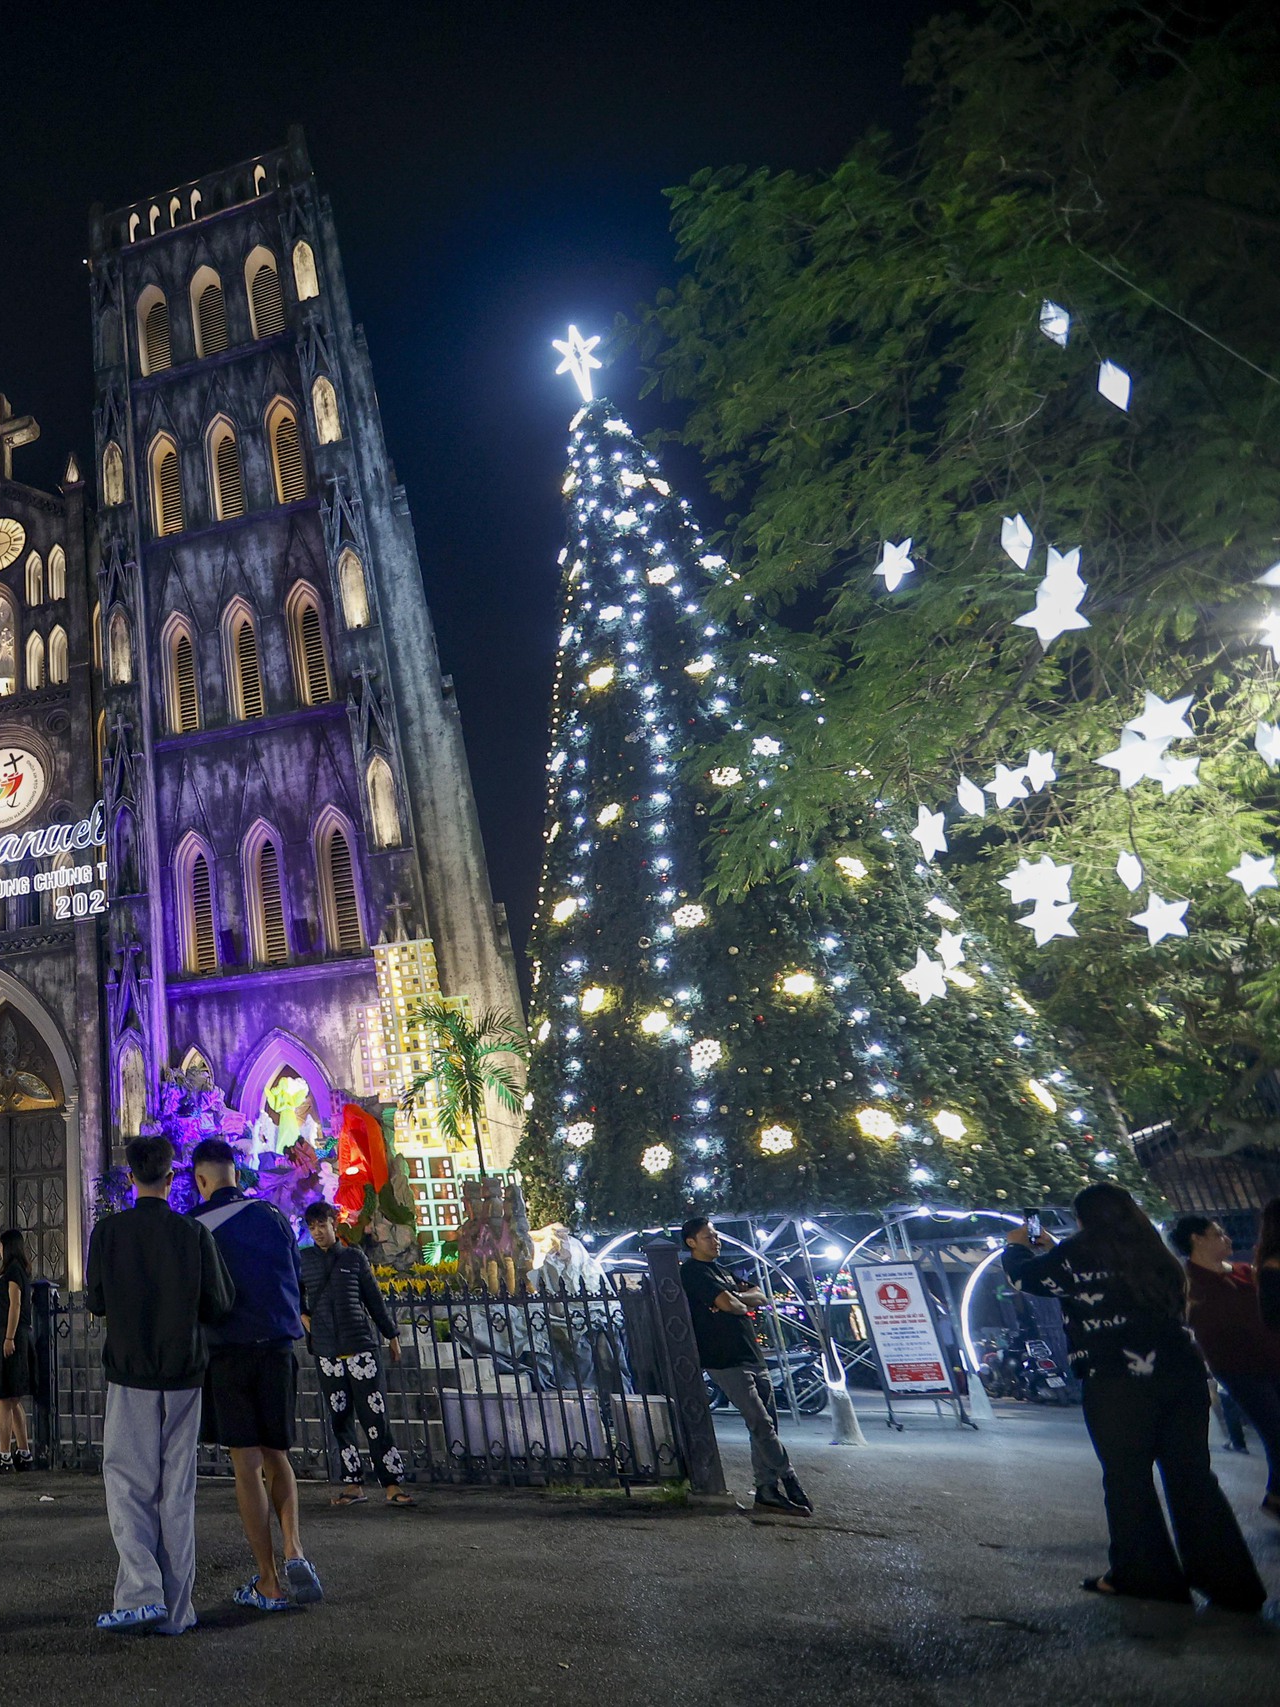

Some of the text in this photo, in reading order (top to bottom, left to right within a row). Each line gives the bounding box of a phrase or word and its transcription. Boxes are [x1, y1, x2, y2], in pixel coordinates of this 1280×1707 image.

[33, 865, 93, 892] CHÚNG
[97, 862, 108, 881] T
[55, 889, 110, 920] 202
